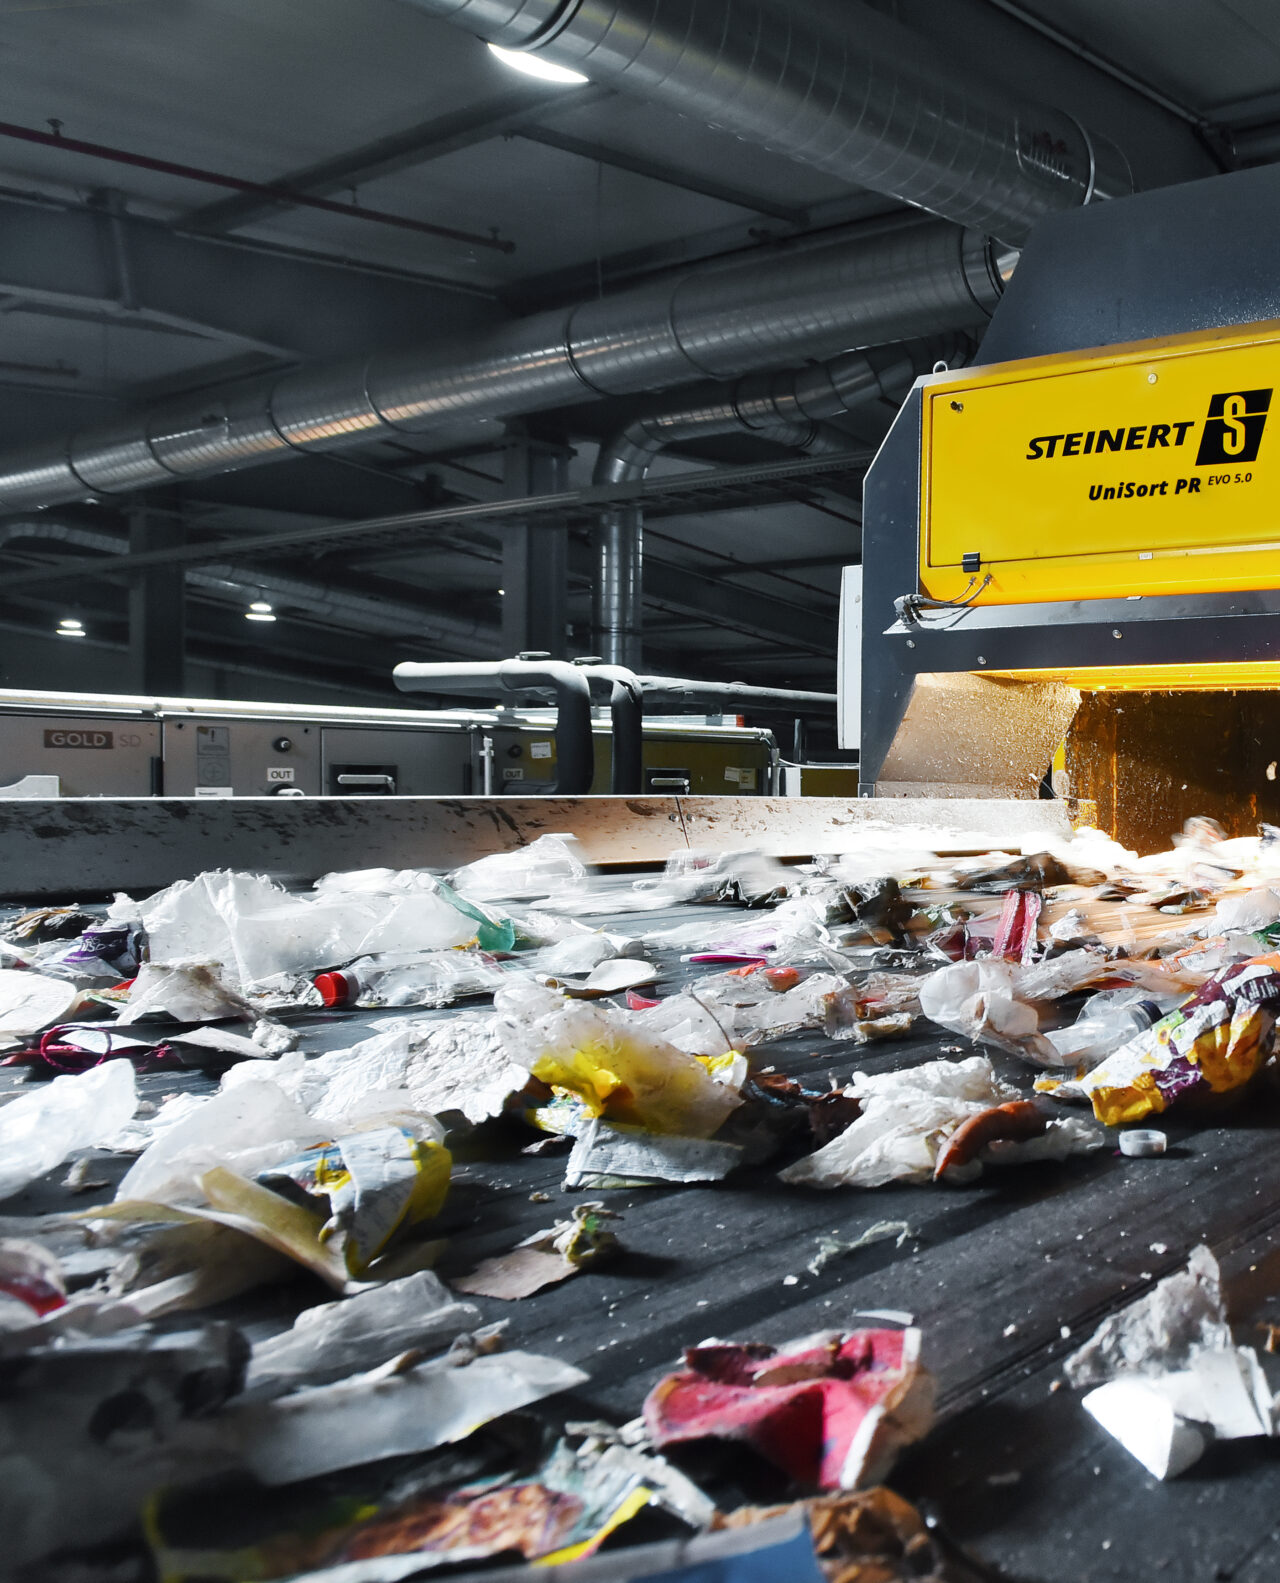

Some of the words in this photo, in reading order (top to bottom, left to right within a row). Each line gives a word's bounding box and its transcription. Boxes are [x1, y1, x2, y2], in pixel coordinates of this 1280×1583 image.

[1026, 421, 1195, 460] STEINERT
[1088, 480, 1169, 501] UniSort
[1174, 477, 1202, 495] PR
[1207, 474, 1231, 486] EVO
[1234, 472, 1253, 484] 5.0
[51, 732, 106, 746] GOLD
[120, 734, 141, 747] SD
[271, 770, 292, 779] OUT
[505, 770, 521, 778] OUT
